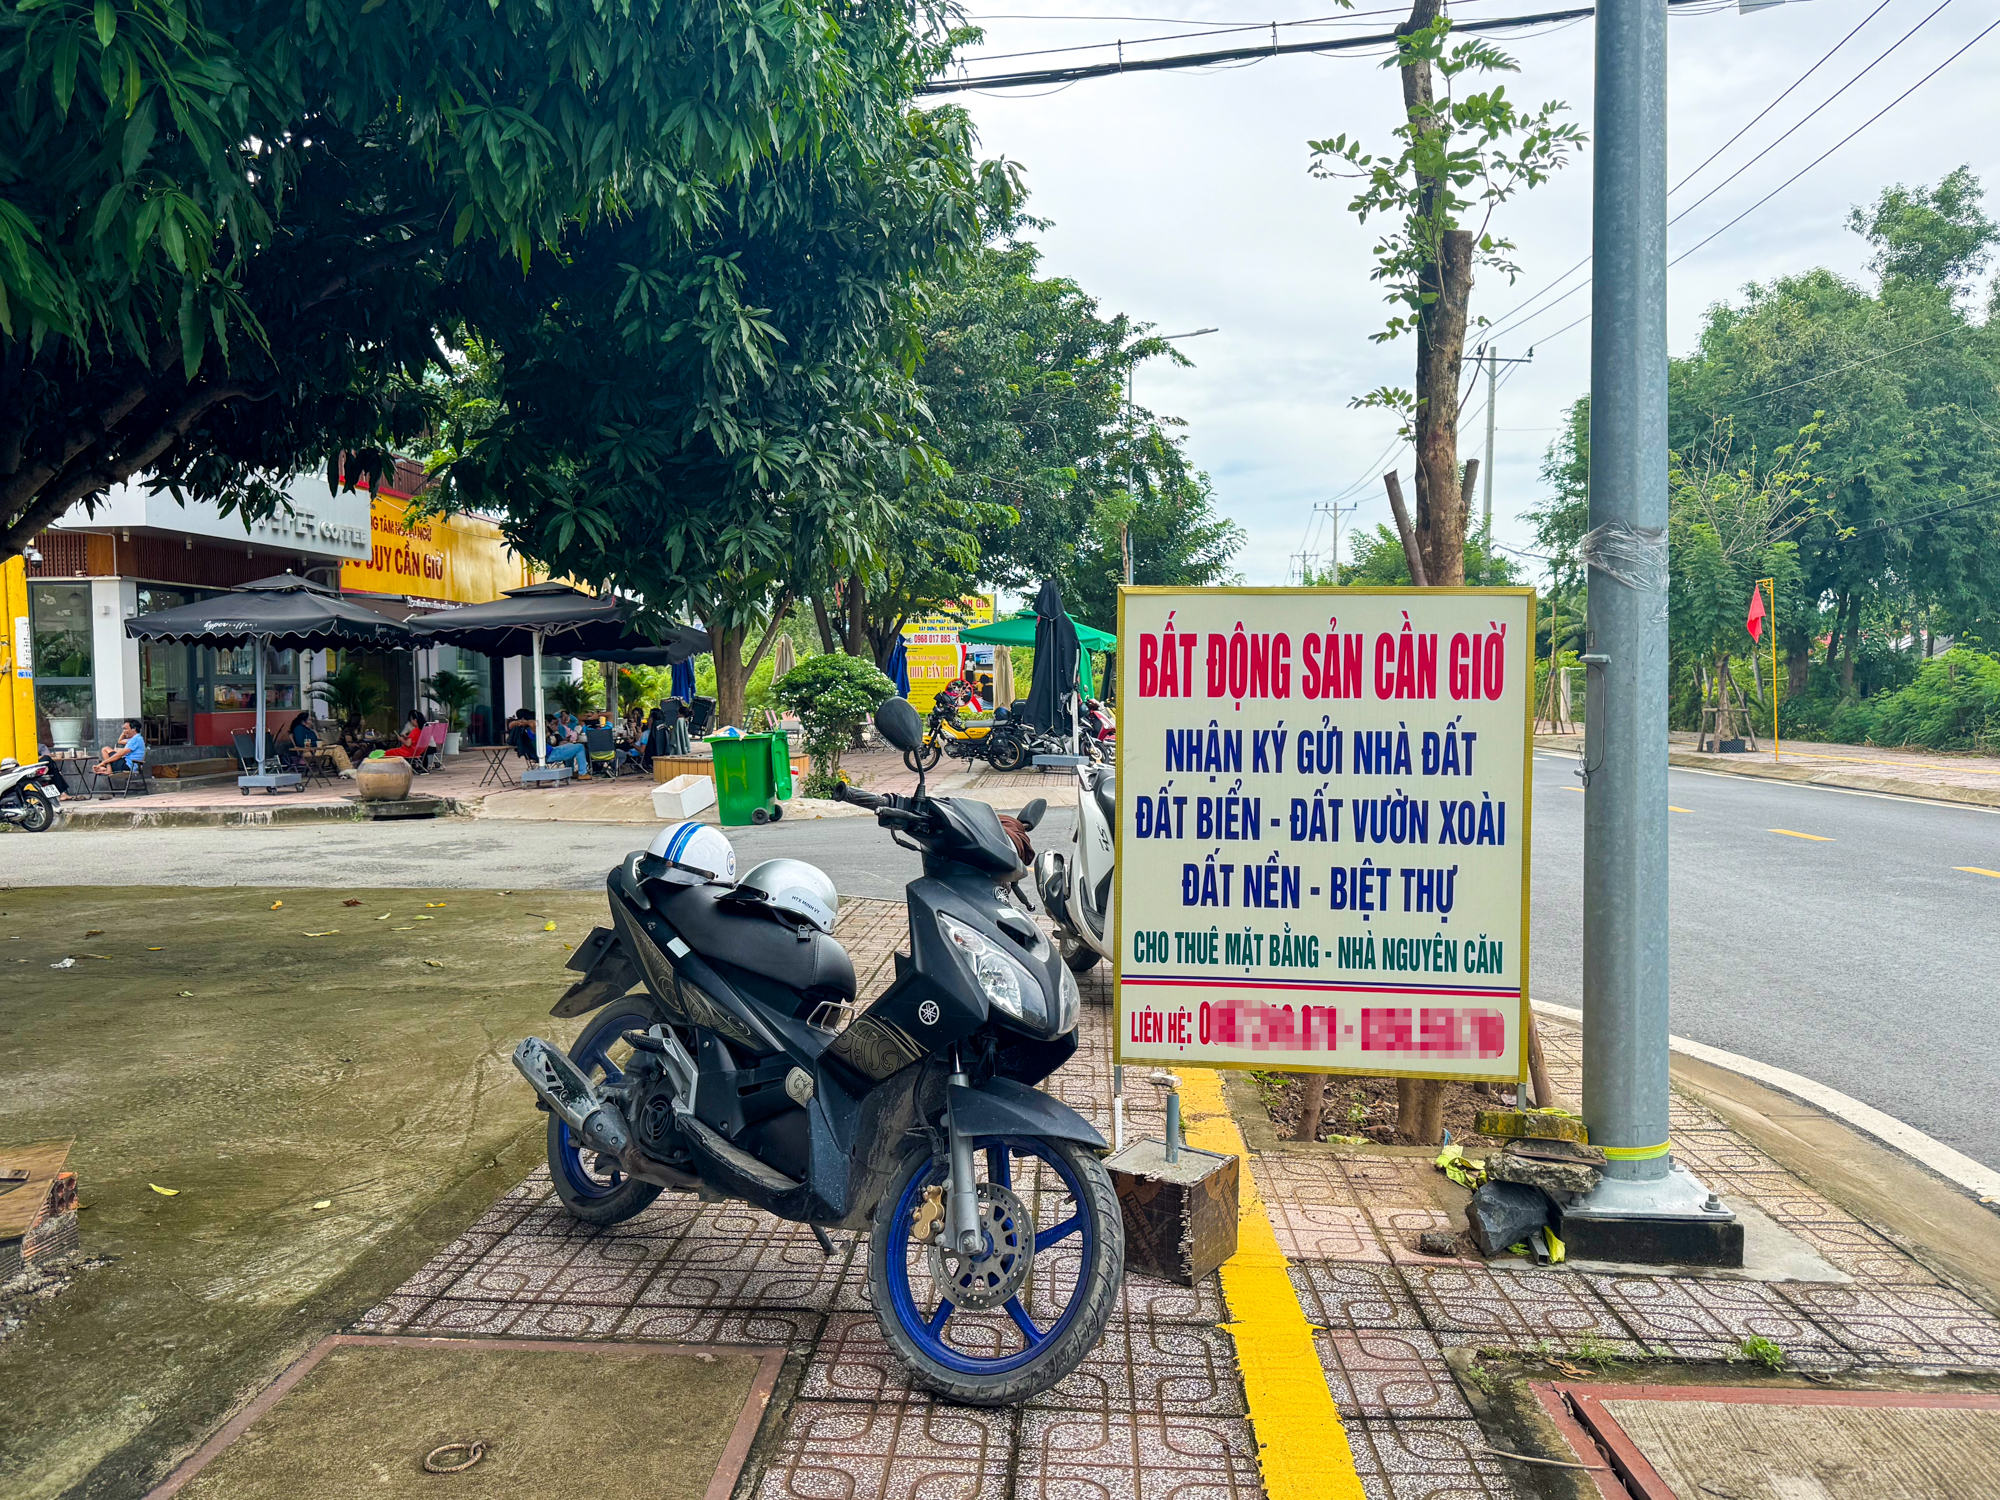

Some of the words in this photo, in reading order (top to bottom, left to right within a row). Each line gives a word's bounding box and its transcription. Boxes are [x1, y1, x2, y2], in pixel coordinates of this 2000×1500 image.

[320, 520, 367, 545] COFFEE
[394, 540, 420, 578] CẦN
[914, 634, 928, 643] 0968
[929, 634, 939, 643] 017
[940, 634, 951, 643] 883
[1138, 610, 1197, 698] BẤT
[1205, 621, 1291, 712] ĐỘNG
[1301, 616, 1364, 700] SẢN
[1374, 610, 1438, 701] CẦN
[1448, 621, 1507, 701] GIỜ
[1165, 719, 1243, 783] NHẬN
[1252, 720, 1288, 774] KÝ
[1297, 714, 1343, 775] GỬI
[1353, 721, 1413, 776] NHÀ
[1421, 714, 1477, 776] ĐẤT
[1135, 779, 1188, 840] ĐẤT
[1196, 778, 1261, 841] BIỂN
[1289, 782, 1344, 843] ĐẤT
[1351, 788, 1429, 844] VƯỜN
[1438, 791, 1506, 846] XOÀI
[1181, 847, 1235, 907] ĐẤT
[1243, 850, 1301, 909] NỀN
[1330, 857, 1392, 922] BIỆT
[1400, 864, 1458, 924] THỰ
[1133, 930, 1169, 964] CHO
[1174, 925, 1219, 965] THUÊ
[1224, 926, 1264, 974] MẶT
[1269, 921, 1319, 969] BẰNG
[1338, 929, 1377, 970] NHÀ
[1382, 931, 1458, 973] NGUYÊN
[1463, 933, 1503, 975] CĂN
[1131, 1004, 1163, 1043] LIÊN
[1167, 1005, 1192, 1051] HỆ:
